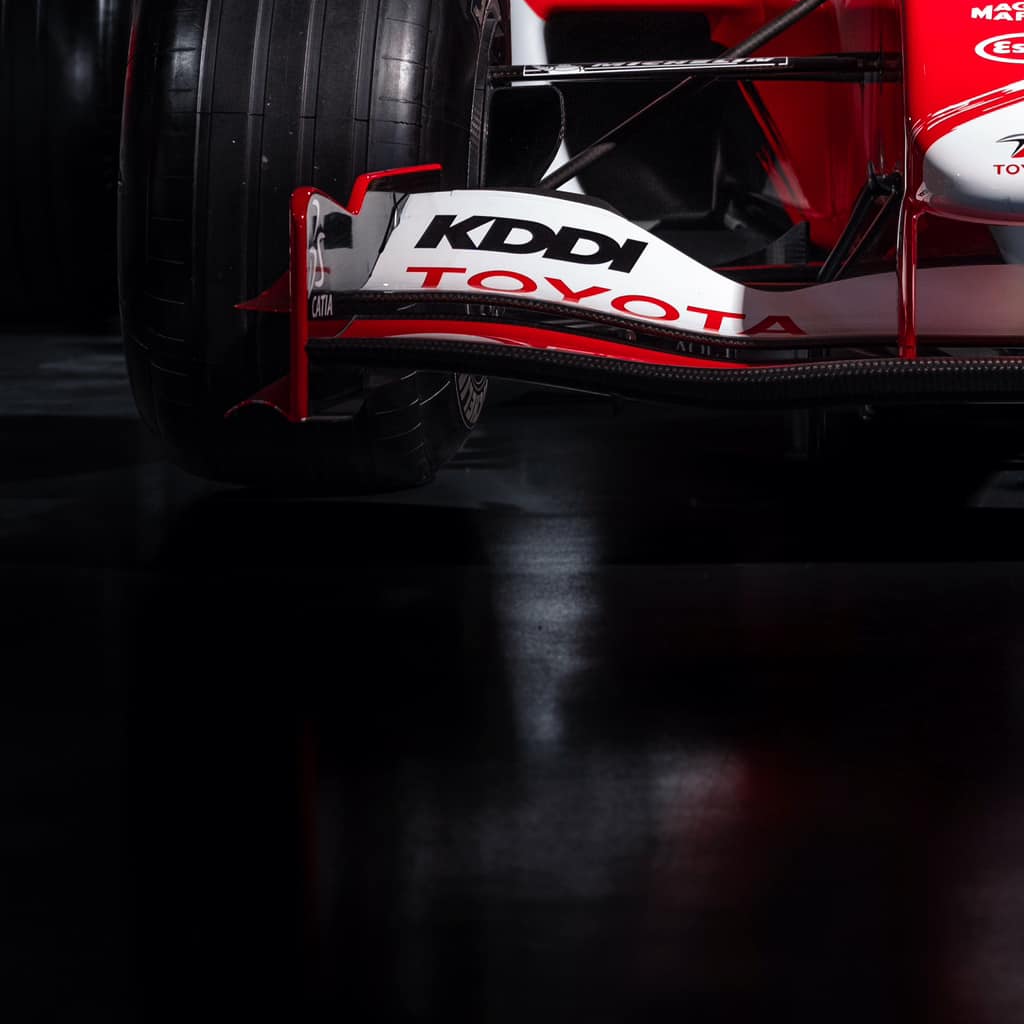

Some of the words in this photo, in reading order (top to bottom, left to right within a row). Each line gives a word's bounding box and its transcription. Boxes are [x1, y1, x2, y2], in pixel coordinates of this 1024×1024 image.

[414, 214, 649, 274] KDDI
[311, 293, 334, 319] CATIA
[405, 266, 809, 336] TOYOTA
